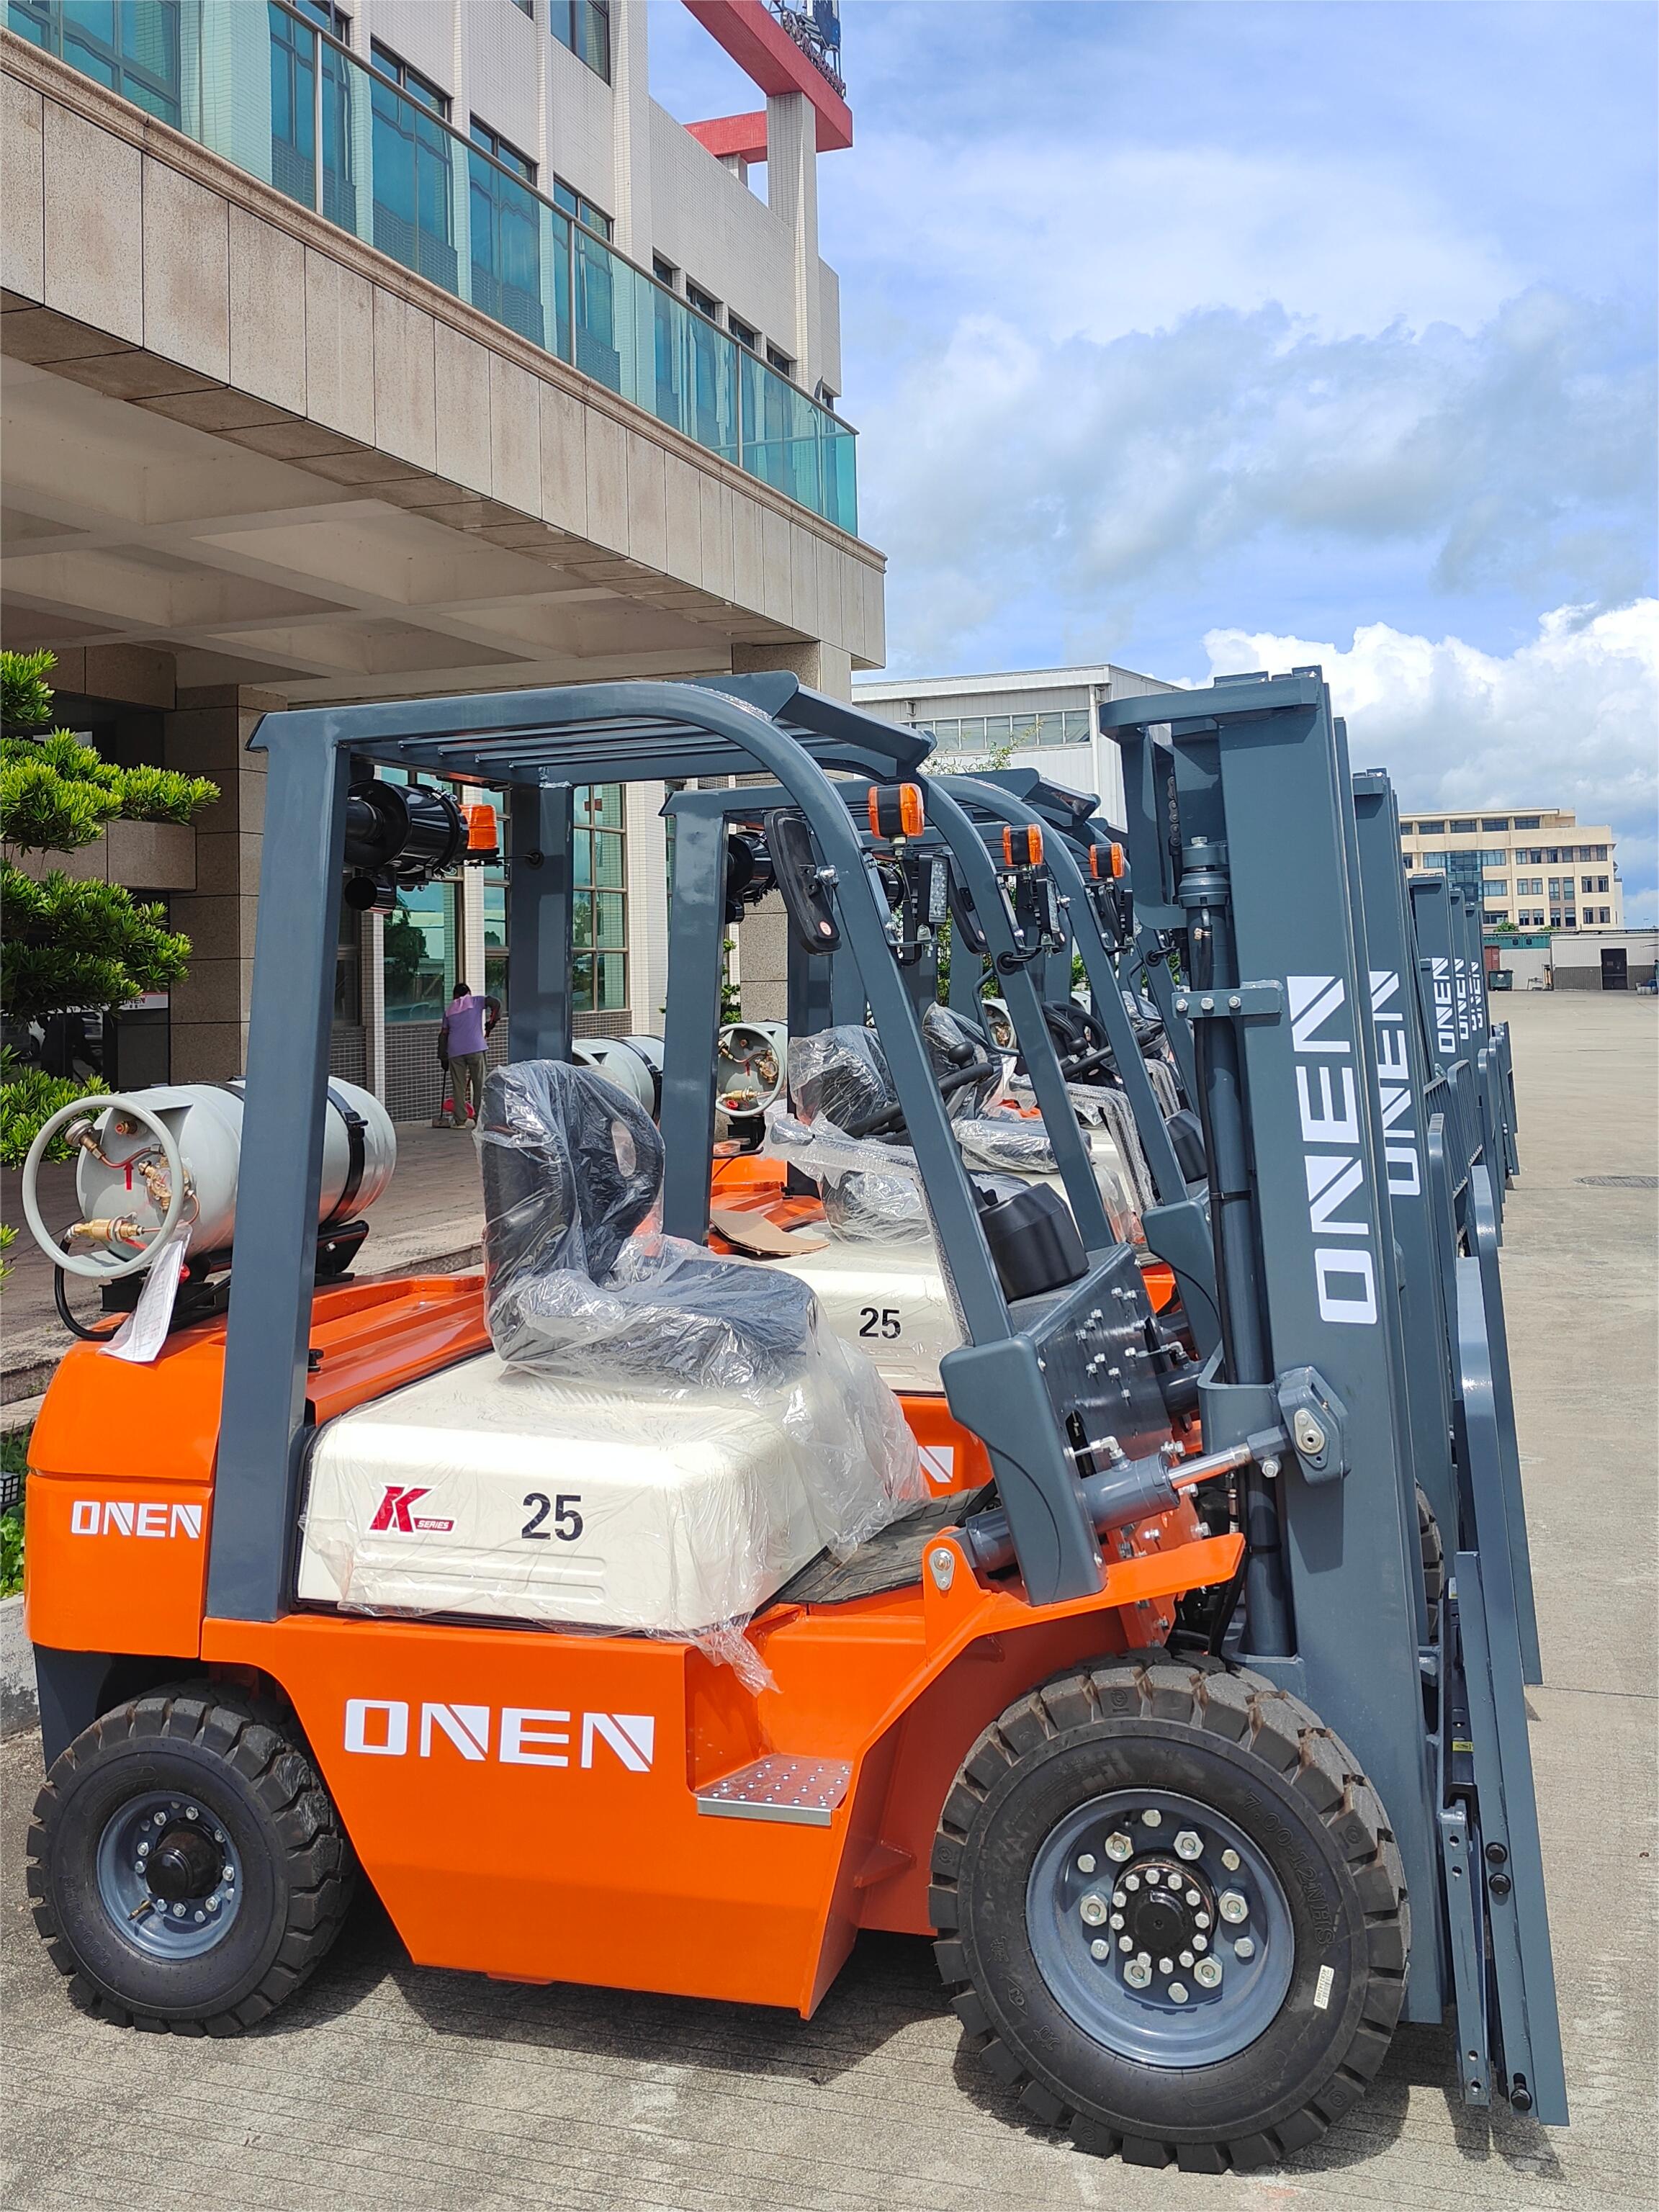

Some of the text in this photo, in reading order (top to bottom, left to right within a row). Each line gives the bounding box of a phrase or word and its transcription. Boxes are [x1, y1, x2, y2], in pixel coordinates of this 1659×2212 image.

[1431, 958, 1455, 1053] ONEN
[1369, 971, 1421, 1195] ONEN
[1287, 976, 1377, 1324] ONEN
[859, 1308, 902, 1339] 25
[71, 1501, 202, 1538] ONEN
[369, 1485, 449, 1532] K SERIES
[522, 1493, 583, 1541] 25
[344, 1699, 655, 1772] ONEN
